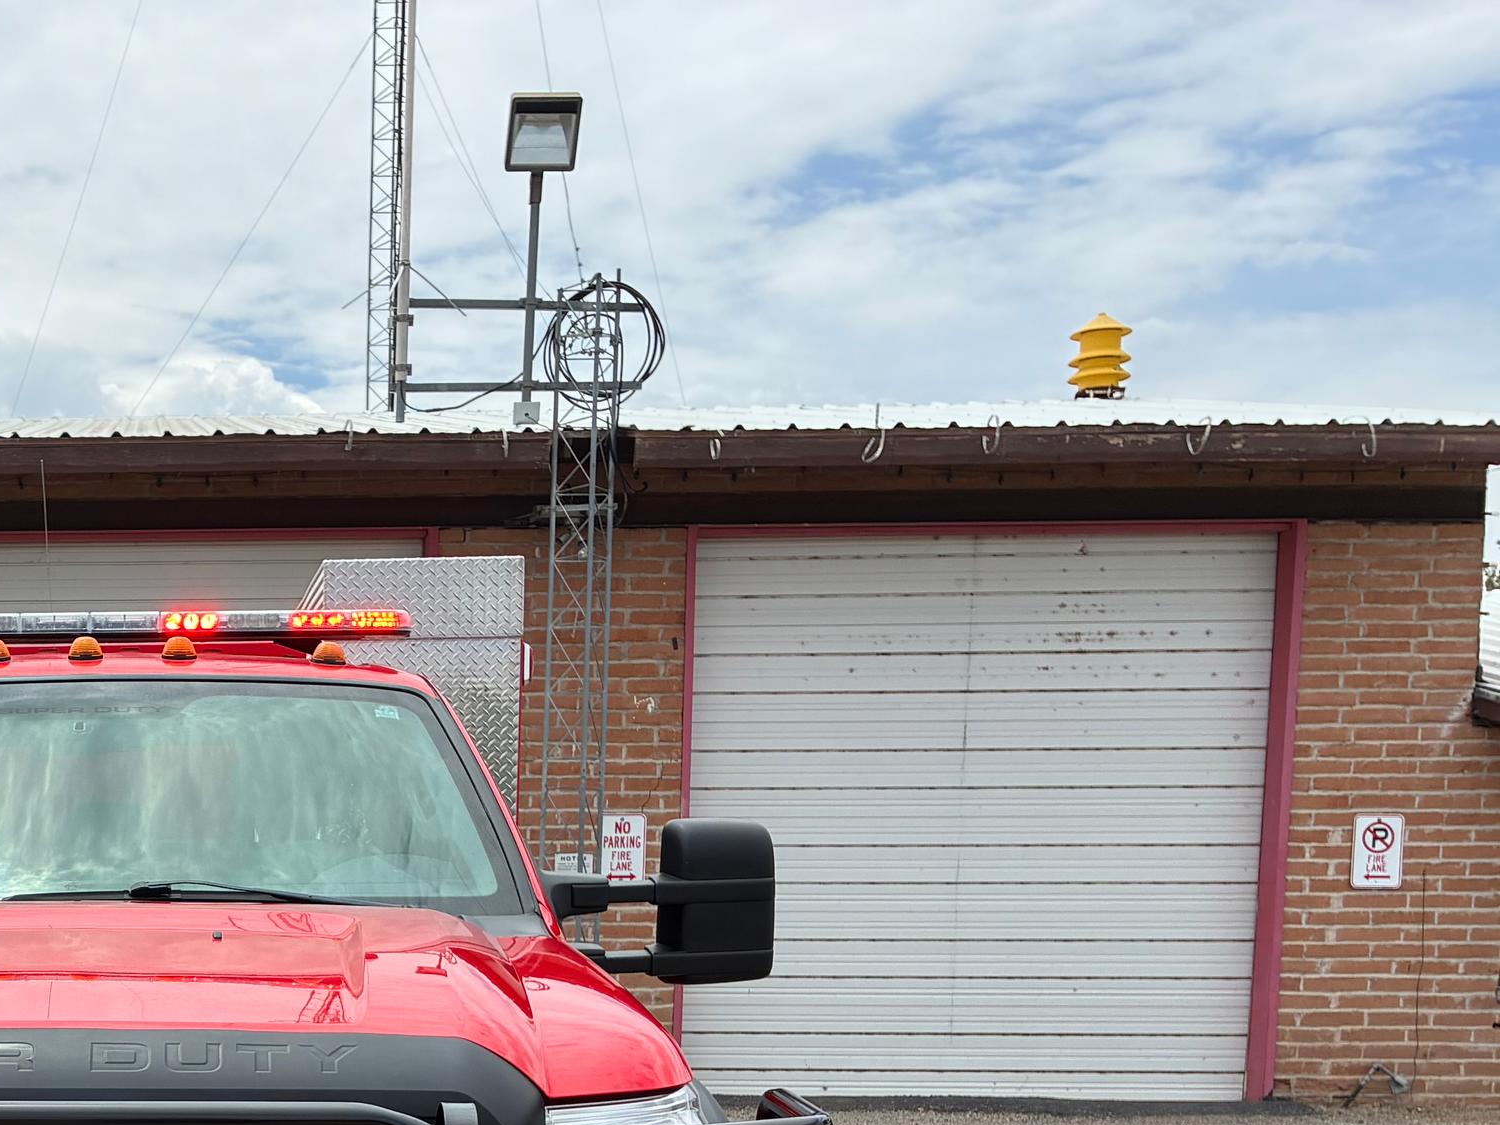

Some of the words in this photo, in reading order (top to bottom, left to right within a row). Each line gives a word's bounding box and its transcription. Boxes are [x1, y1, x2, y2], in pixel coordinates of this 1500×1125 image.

[614, 822, 631, 834] NO
[603, 836, 641, 849] PARKING
[611, 851, 632, 861] FIRE
[1367, 855, 1386, 864] FIRE
[609, 862, 633, 872] LANE
[1365, 864, 1386, 873] LANE
[90, 1042, 358, 1074] DUTY
